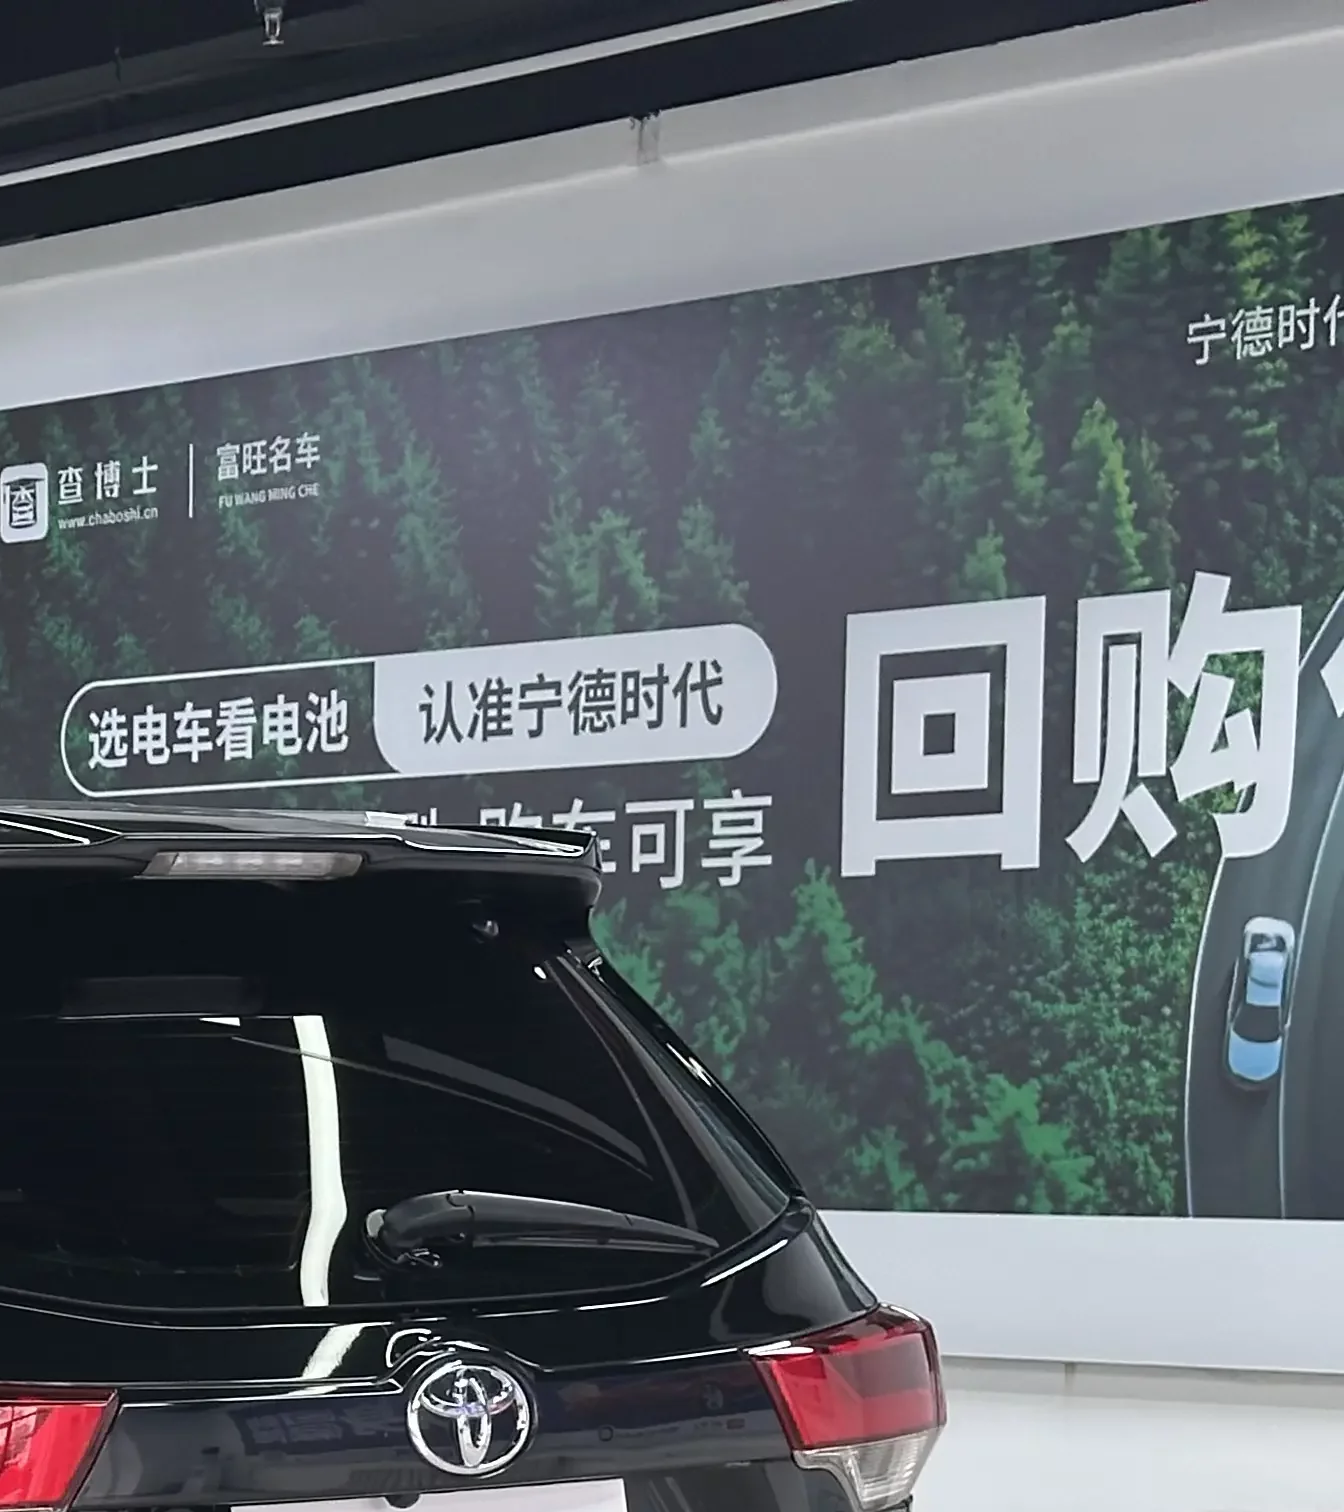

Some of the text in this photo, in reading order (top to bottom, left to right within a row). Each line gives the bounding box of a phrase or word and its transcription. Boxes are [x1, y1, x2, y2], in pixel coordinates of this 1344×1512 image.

[57, 455, 159, 505] 查博士
[216, 431, 320, 481] 富旺名车
[57, 506, 159, 530] www.chaboshi.cn
[87, 689, 349, 770] 选电车看电池
[418, 659, 724, 745] 认准宁德时代
[841, 571, 1344, 877] 回购
